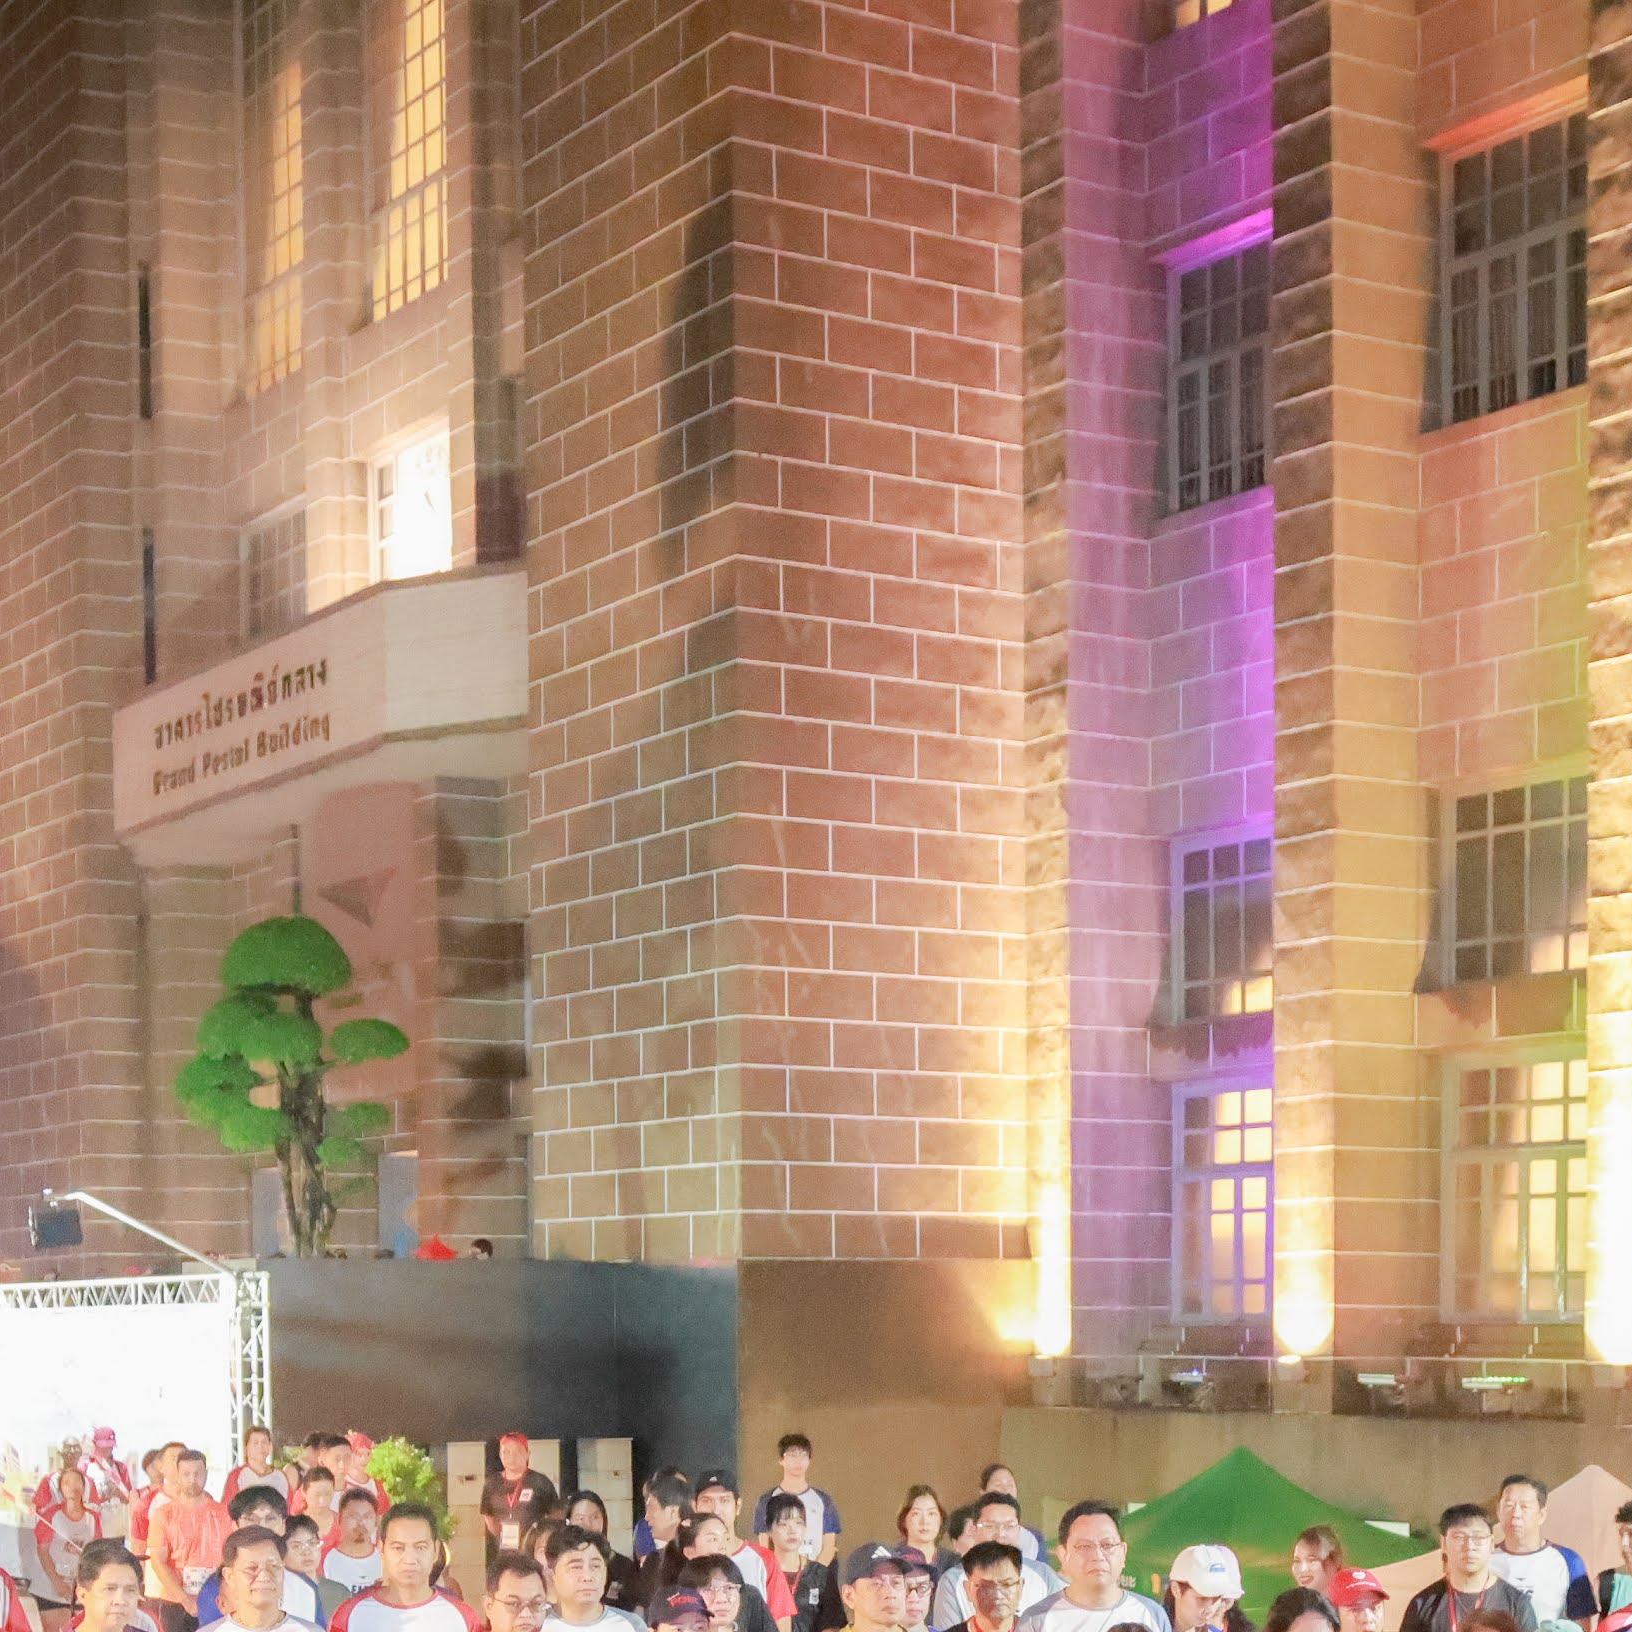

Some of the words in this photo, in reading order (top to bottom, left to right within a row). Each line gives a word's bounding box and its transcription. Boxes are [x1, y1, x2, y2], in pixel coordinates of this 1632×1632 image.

[153, 755, 196, 795] Grand
[203, 737, 250, 778] Postal
[256, 713, 329, 758] Building
